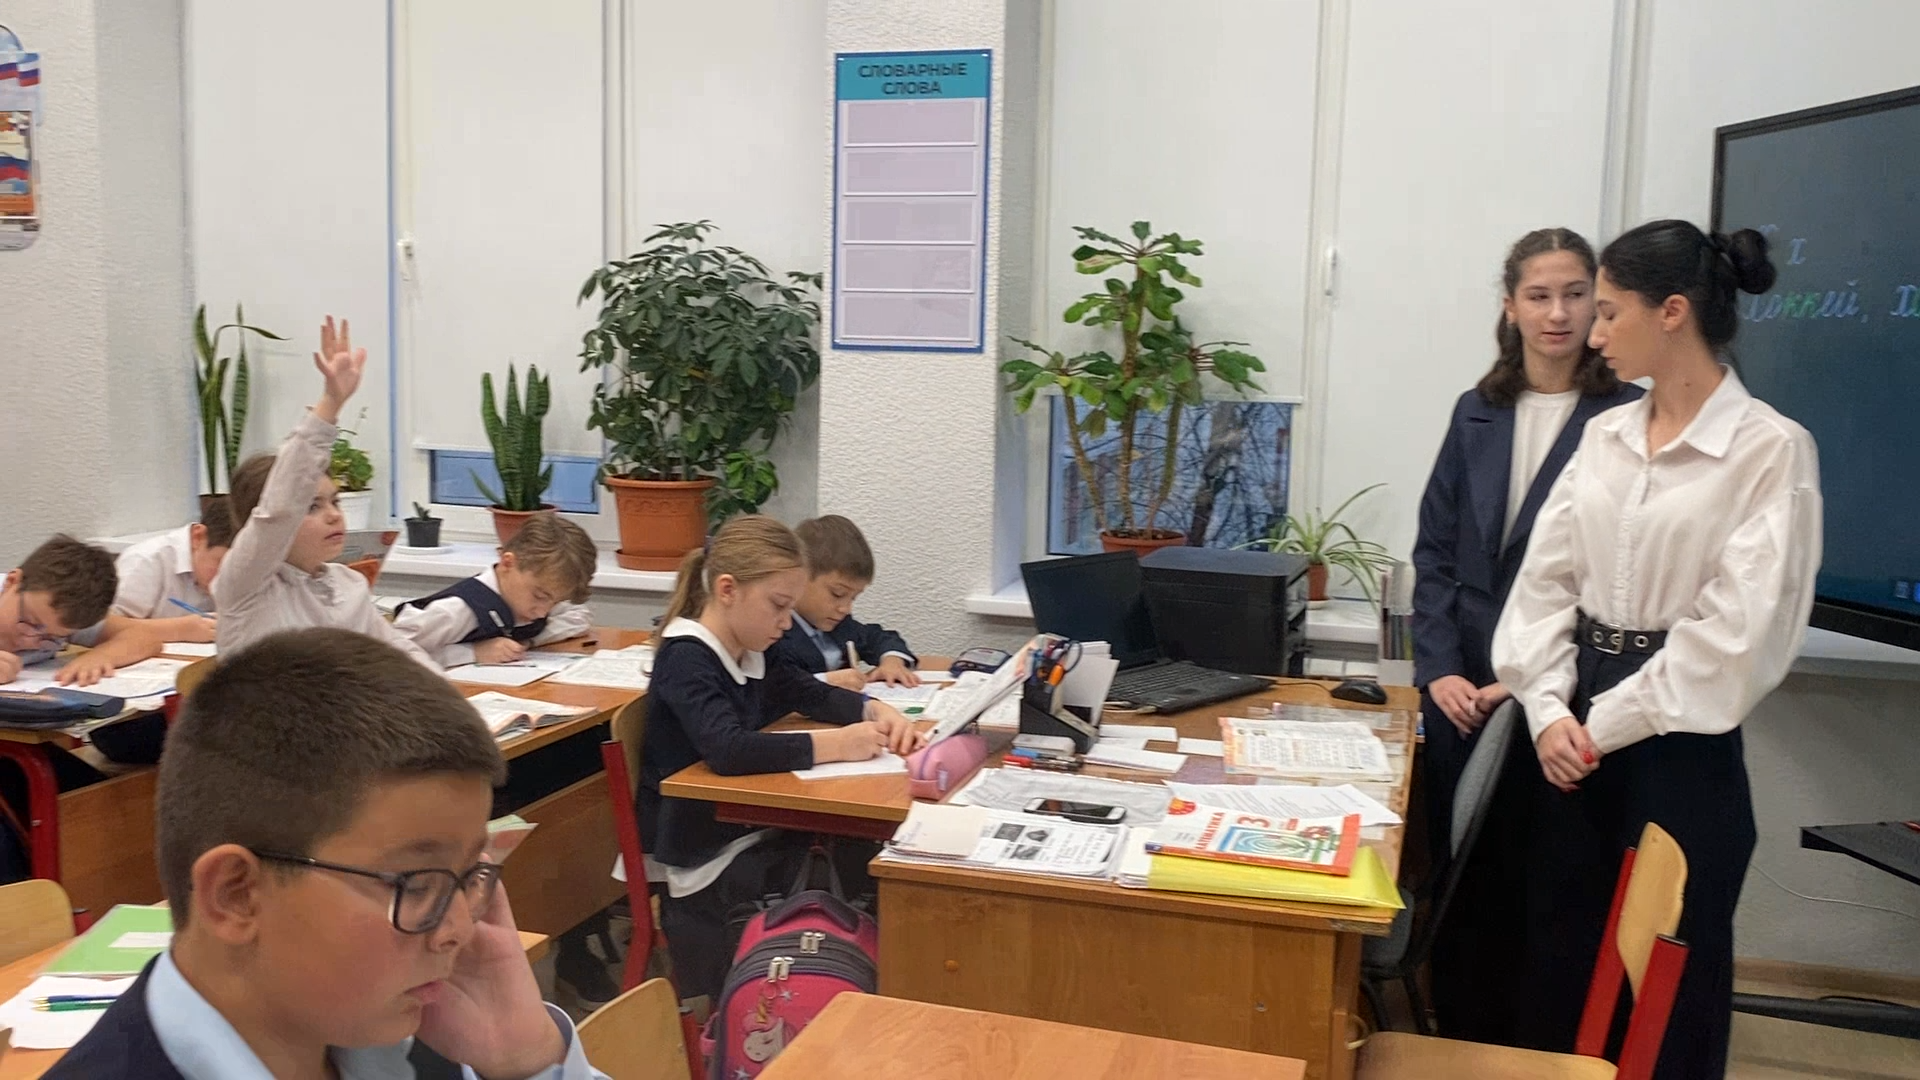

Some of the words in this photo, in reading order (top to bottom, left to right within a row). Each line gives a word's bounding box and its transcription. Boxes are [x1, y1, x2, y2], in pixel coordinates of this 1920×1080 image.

[858, 63, 968, 78] СЛОВАРНЫЕ
[882, 81, 942, 95] СЛОВА
[1237, 816, 1270, 828] 3
